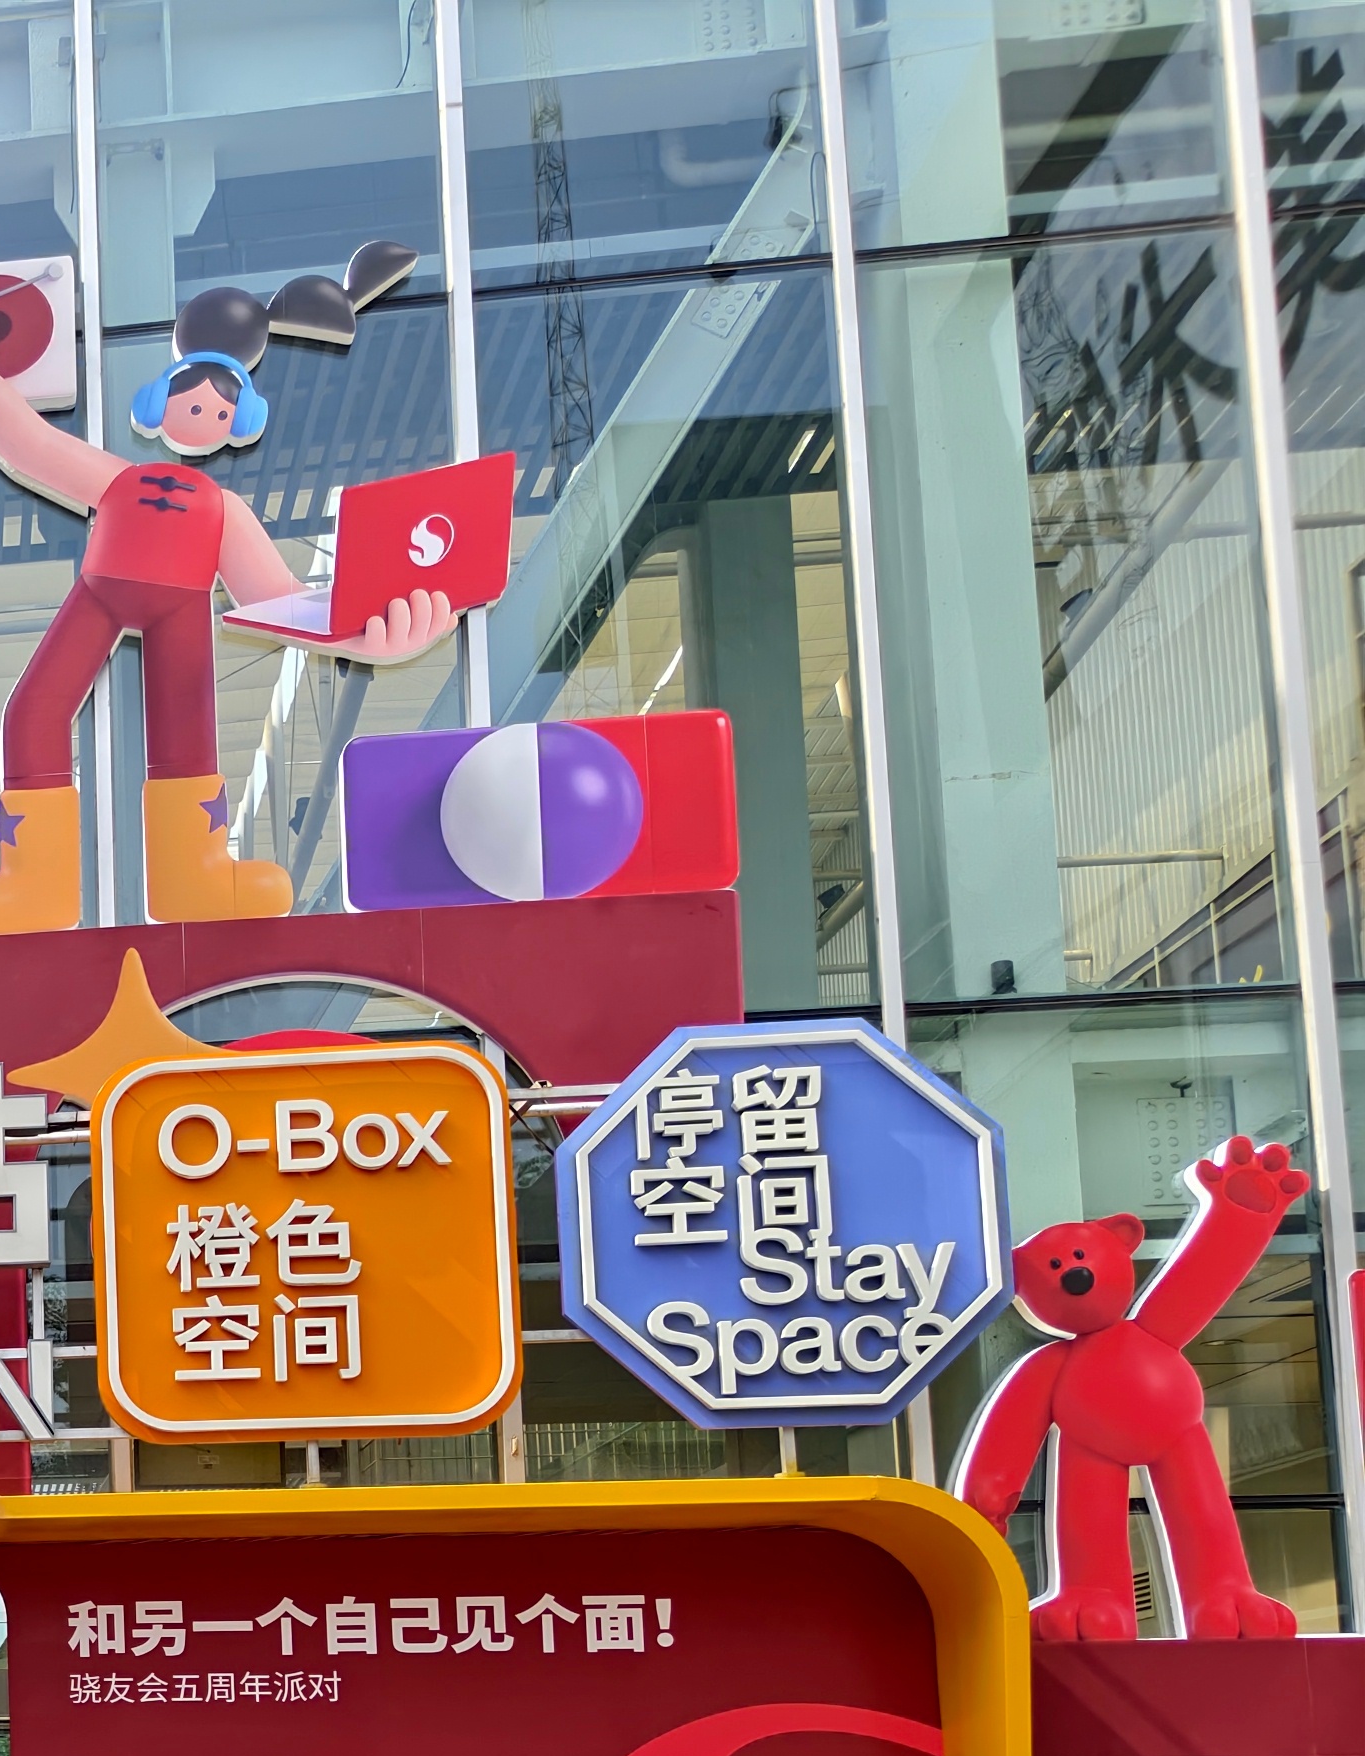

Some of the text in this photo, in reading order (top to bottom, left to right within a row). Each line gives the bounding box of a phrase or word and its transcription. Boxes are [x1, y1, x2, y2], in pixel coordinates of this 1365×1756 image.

[157, 1097, 454, 1181] O-Box
[633, 1063, 823, 1163] 停留
[165, 1198, 364, 1294] 橙色
[630, 1154, 832, 1248] 空间
[738, 1225, 957, 1322] Stay
[172, 1293, 364, 1384] 空间
[645, 1300, 956, 1395] Space
[68, 1669, 343, 1705] 骁友会五周年派对
